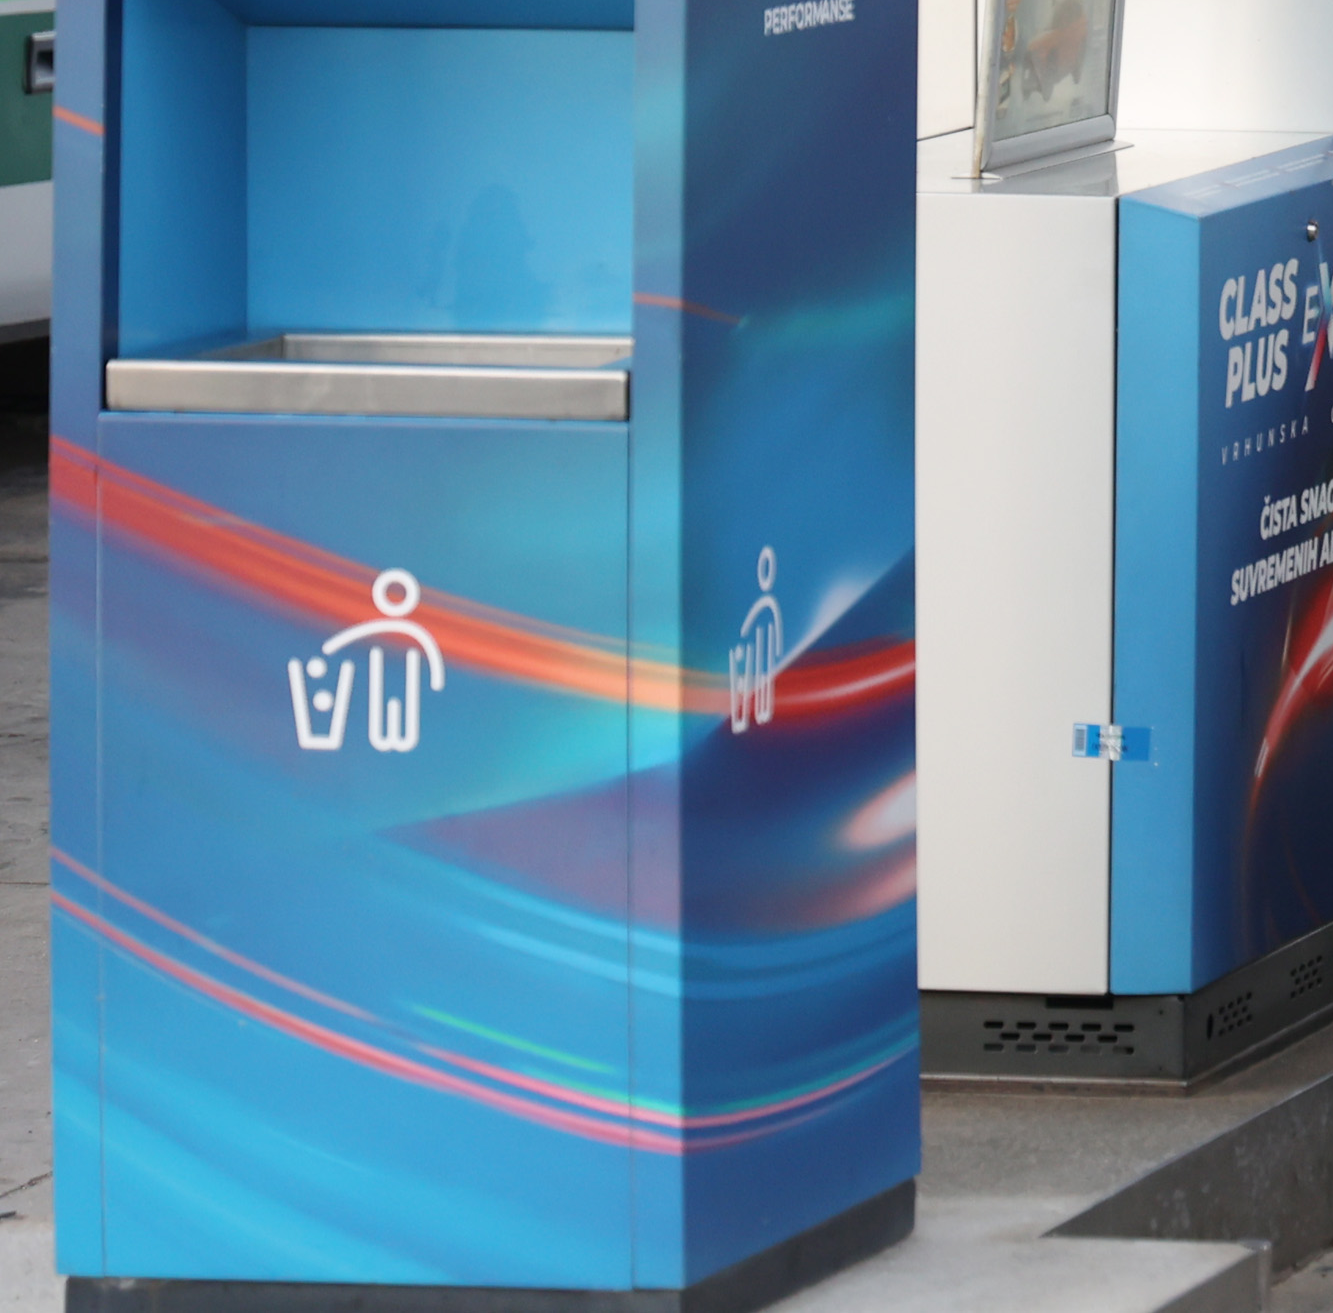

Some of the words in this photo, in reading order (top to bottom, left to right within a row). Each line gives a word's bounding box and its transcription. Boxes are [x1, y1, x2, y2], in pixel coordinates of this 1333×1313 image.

[1218, 258, 1299, 341] CLASS
[1225, 329, 1290, 409] PLUS
[1221, 415, 1309, 465] VRHUNSKA
[1260, 494, 1299, 541] ČISTA
[1230, 536, 1319, 606] SUVREMENIH
